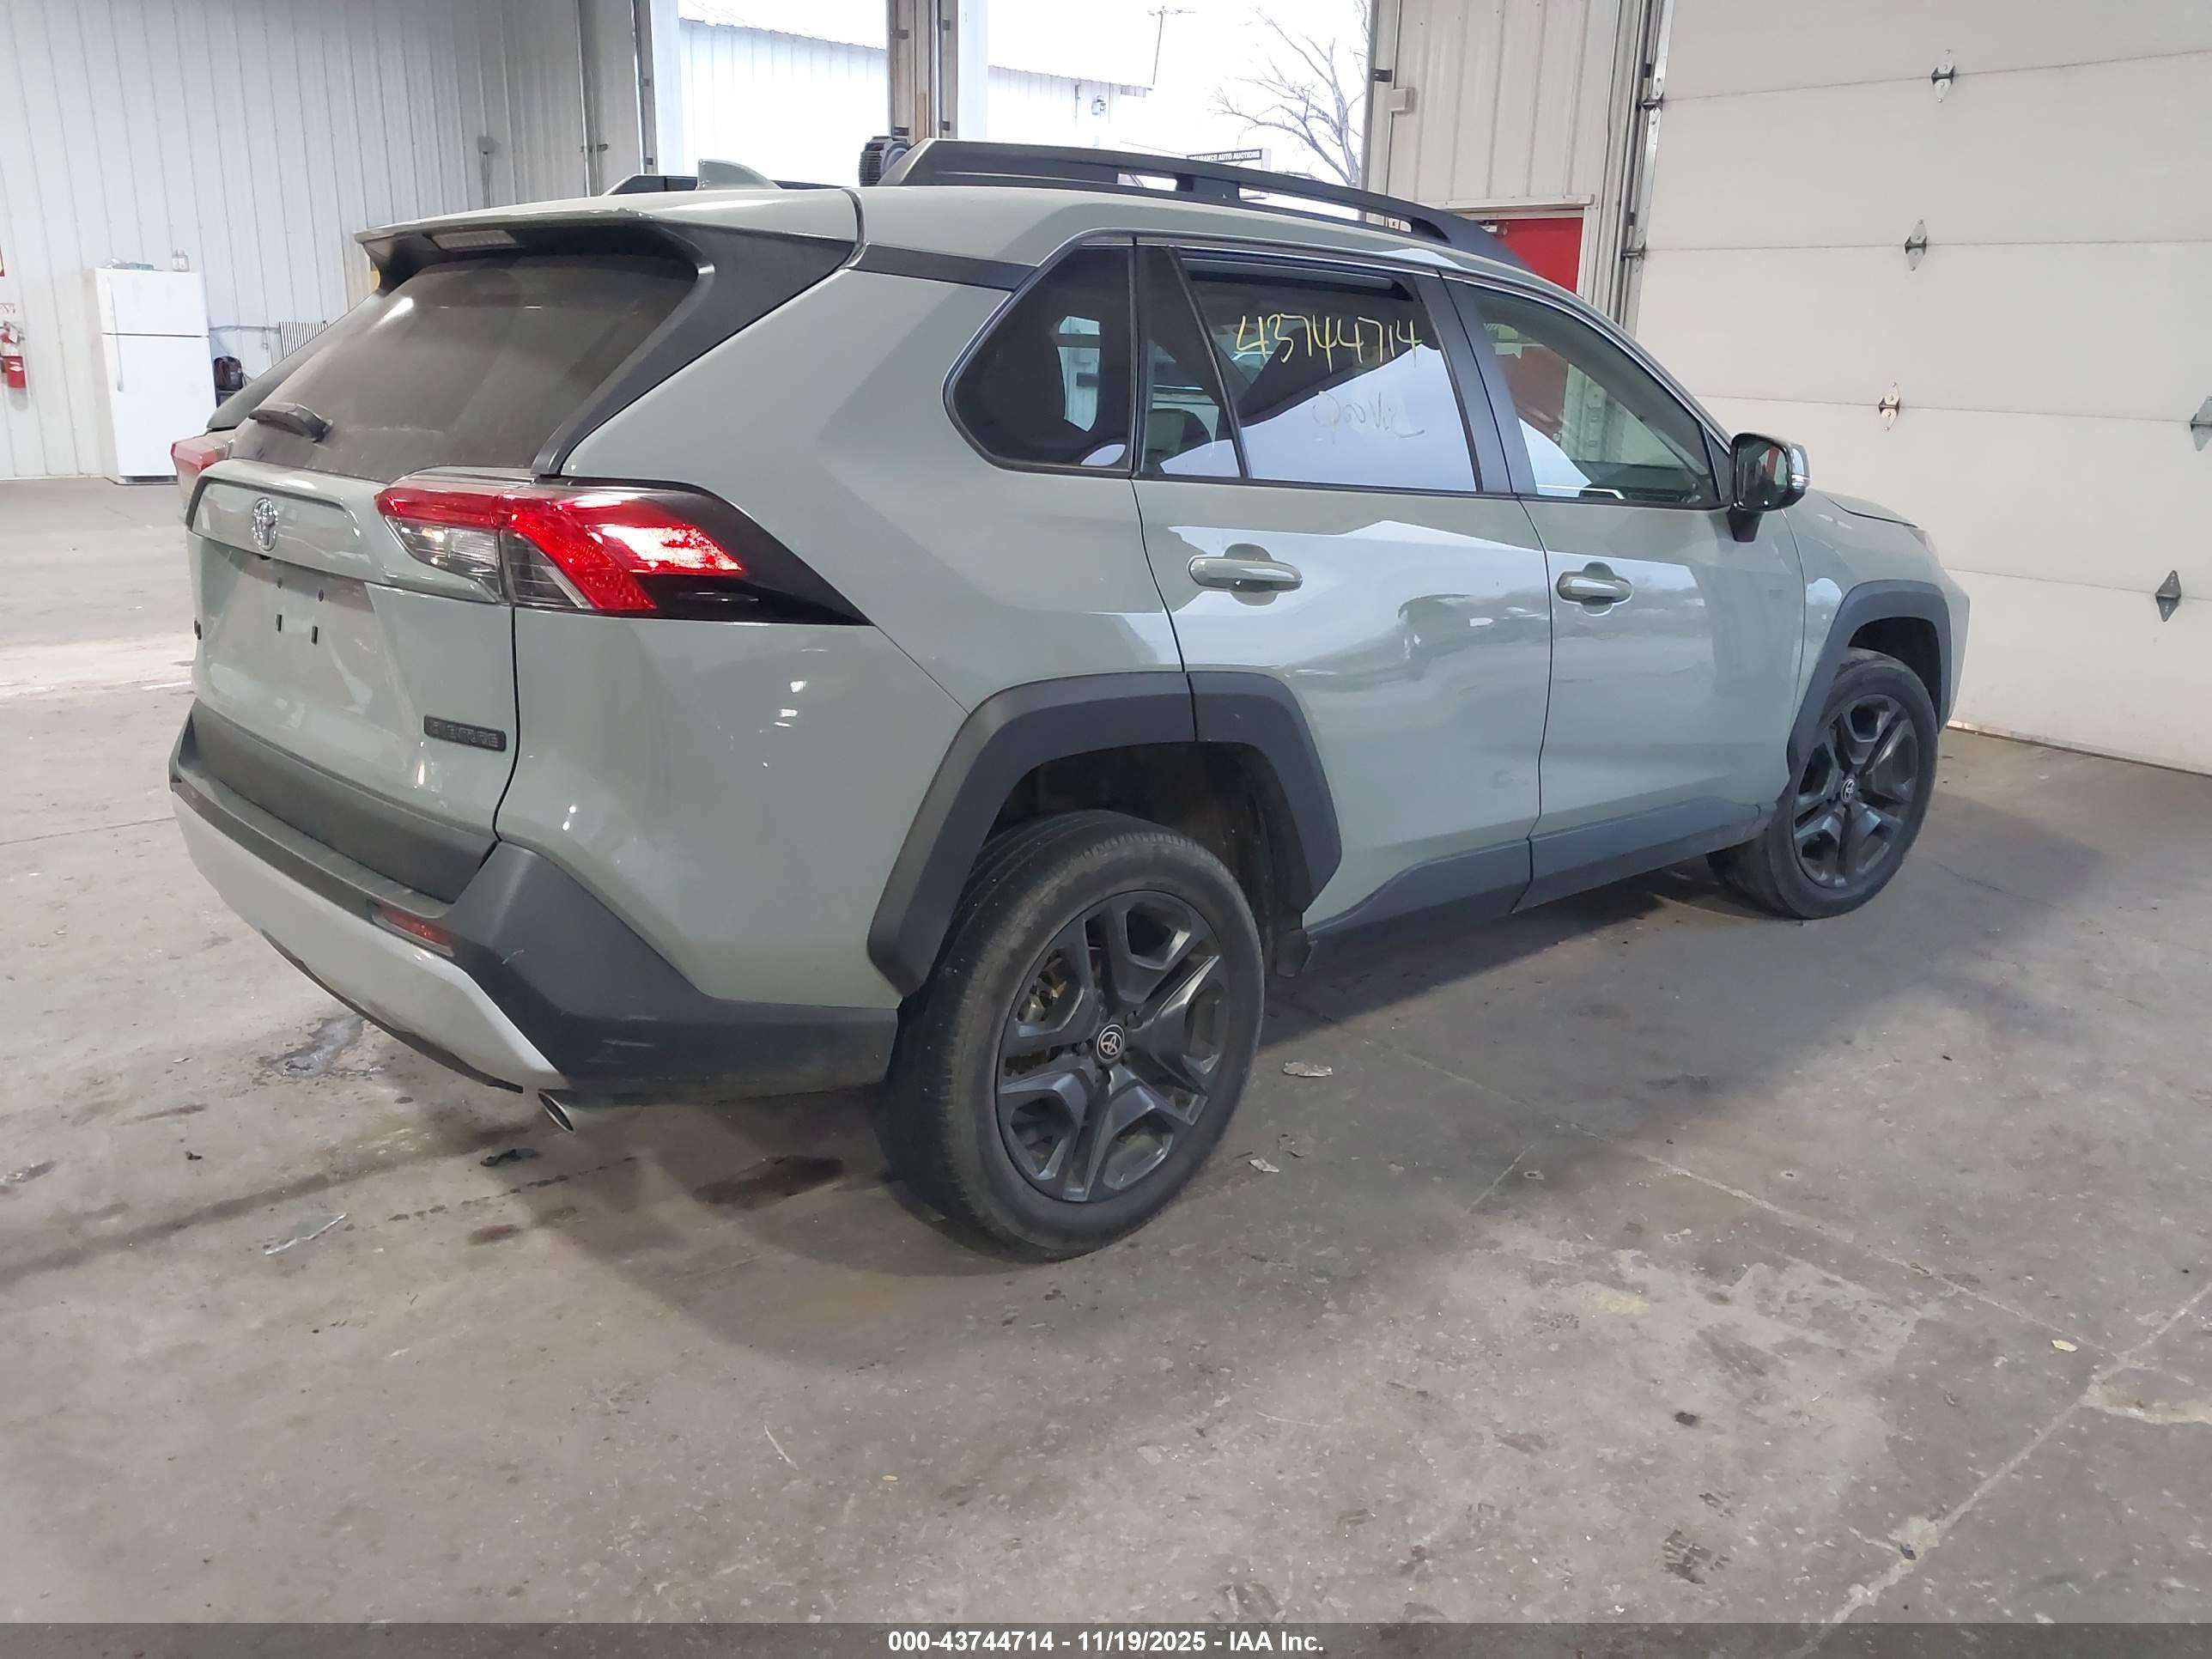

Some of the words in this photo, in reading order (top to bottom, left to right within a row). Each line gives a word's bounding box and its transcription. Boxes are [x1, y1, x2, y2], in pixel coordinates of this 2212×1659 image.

[1218, 153, 1232, 161] AUTO
[1233, 150, 1261, 160] AUCTIONS
[1237, 313, 1423, 373] 43744714
